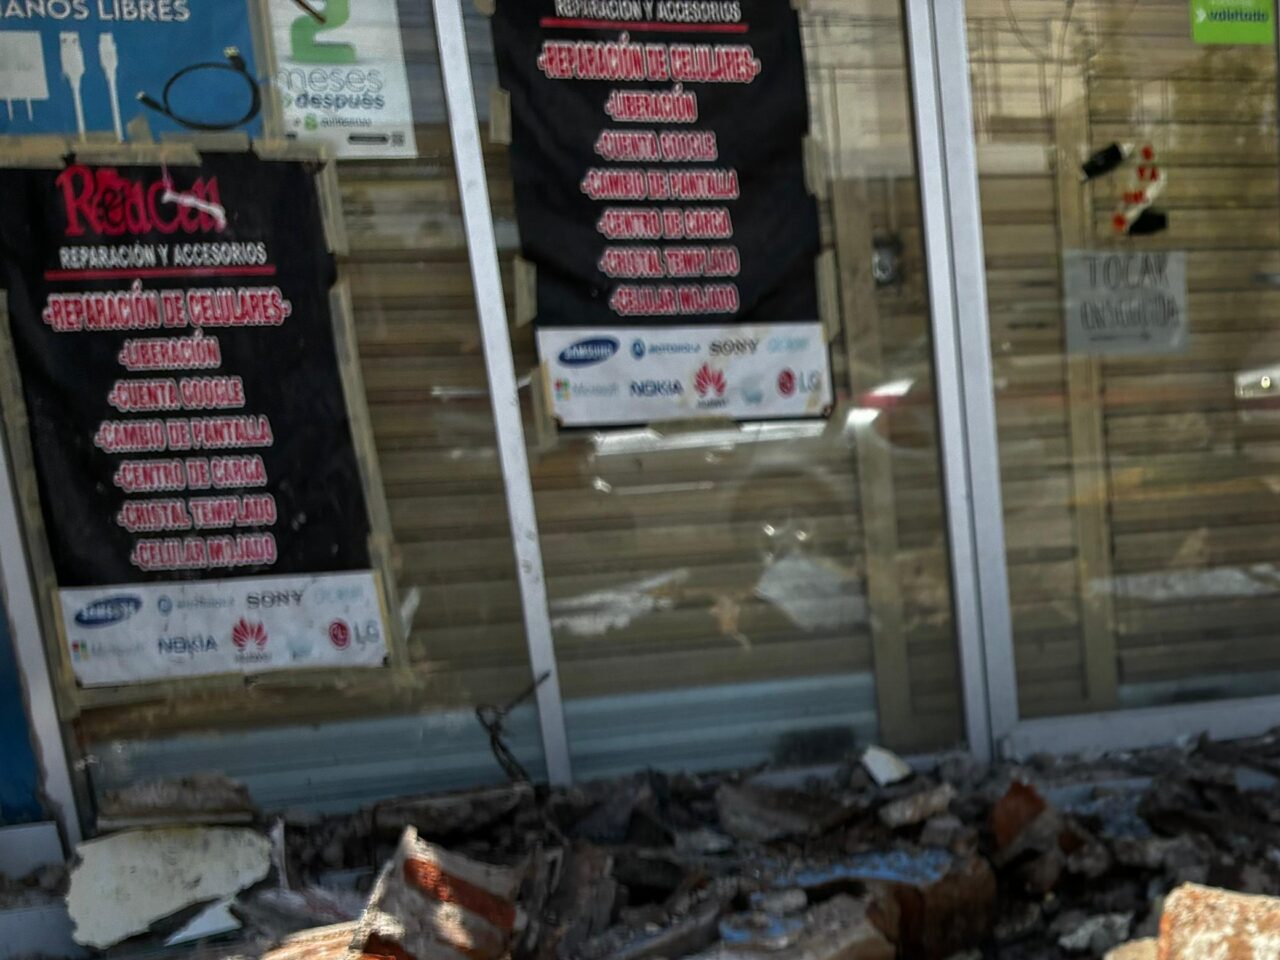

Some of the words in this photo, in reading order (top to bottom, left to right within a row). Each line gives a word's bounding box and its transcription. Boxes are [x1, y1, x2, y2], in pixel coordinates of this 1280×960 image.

[0, 0, 89, 20] ANOS
[98, 0, 191, 22] LIBRES
[657, 1, 741, 22] ACCESORIOS
[290, 0, 357, 64] 2
[645, 45, 669, 80] DE
[277, 67, 384, 94] meses
[295, 89, 385, 113] después
[646, 169, 669, 199] DE
[662, 207, 683, 238] DE
[59, 240, 156, 269] REPARACIÓN
[158, 245, 170, 267] Y
[173, 241, 267, 266] ACCESORIOS
[1083, 253, 1170, 290] TOCAR
[161, 289, 187, 328] DE
[709, 338, 760, 357] SONY
[629, 380, 684, 398] NOKIA
[166, 417, 191, 450] DE
[190, 414, 273, 449] PANTALLA
[185, 458, 210, 490] DE
[209, 454, 267, 487] CARGA
[246, 589, 304, 610] SONY
[158, 636, 218, 657] NOKIA
